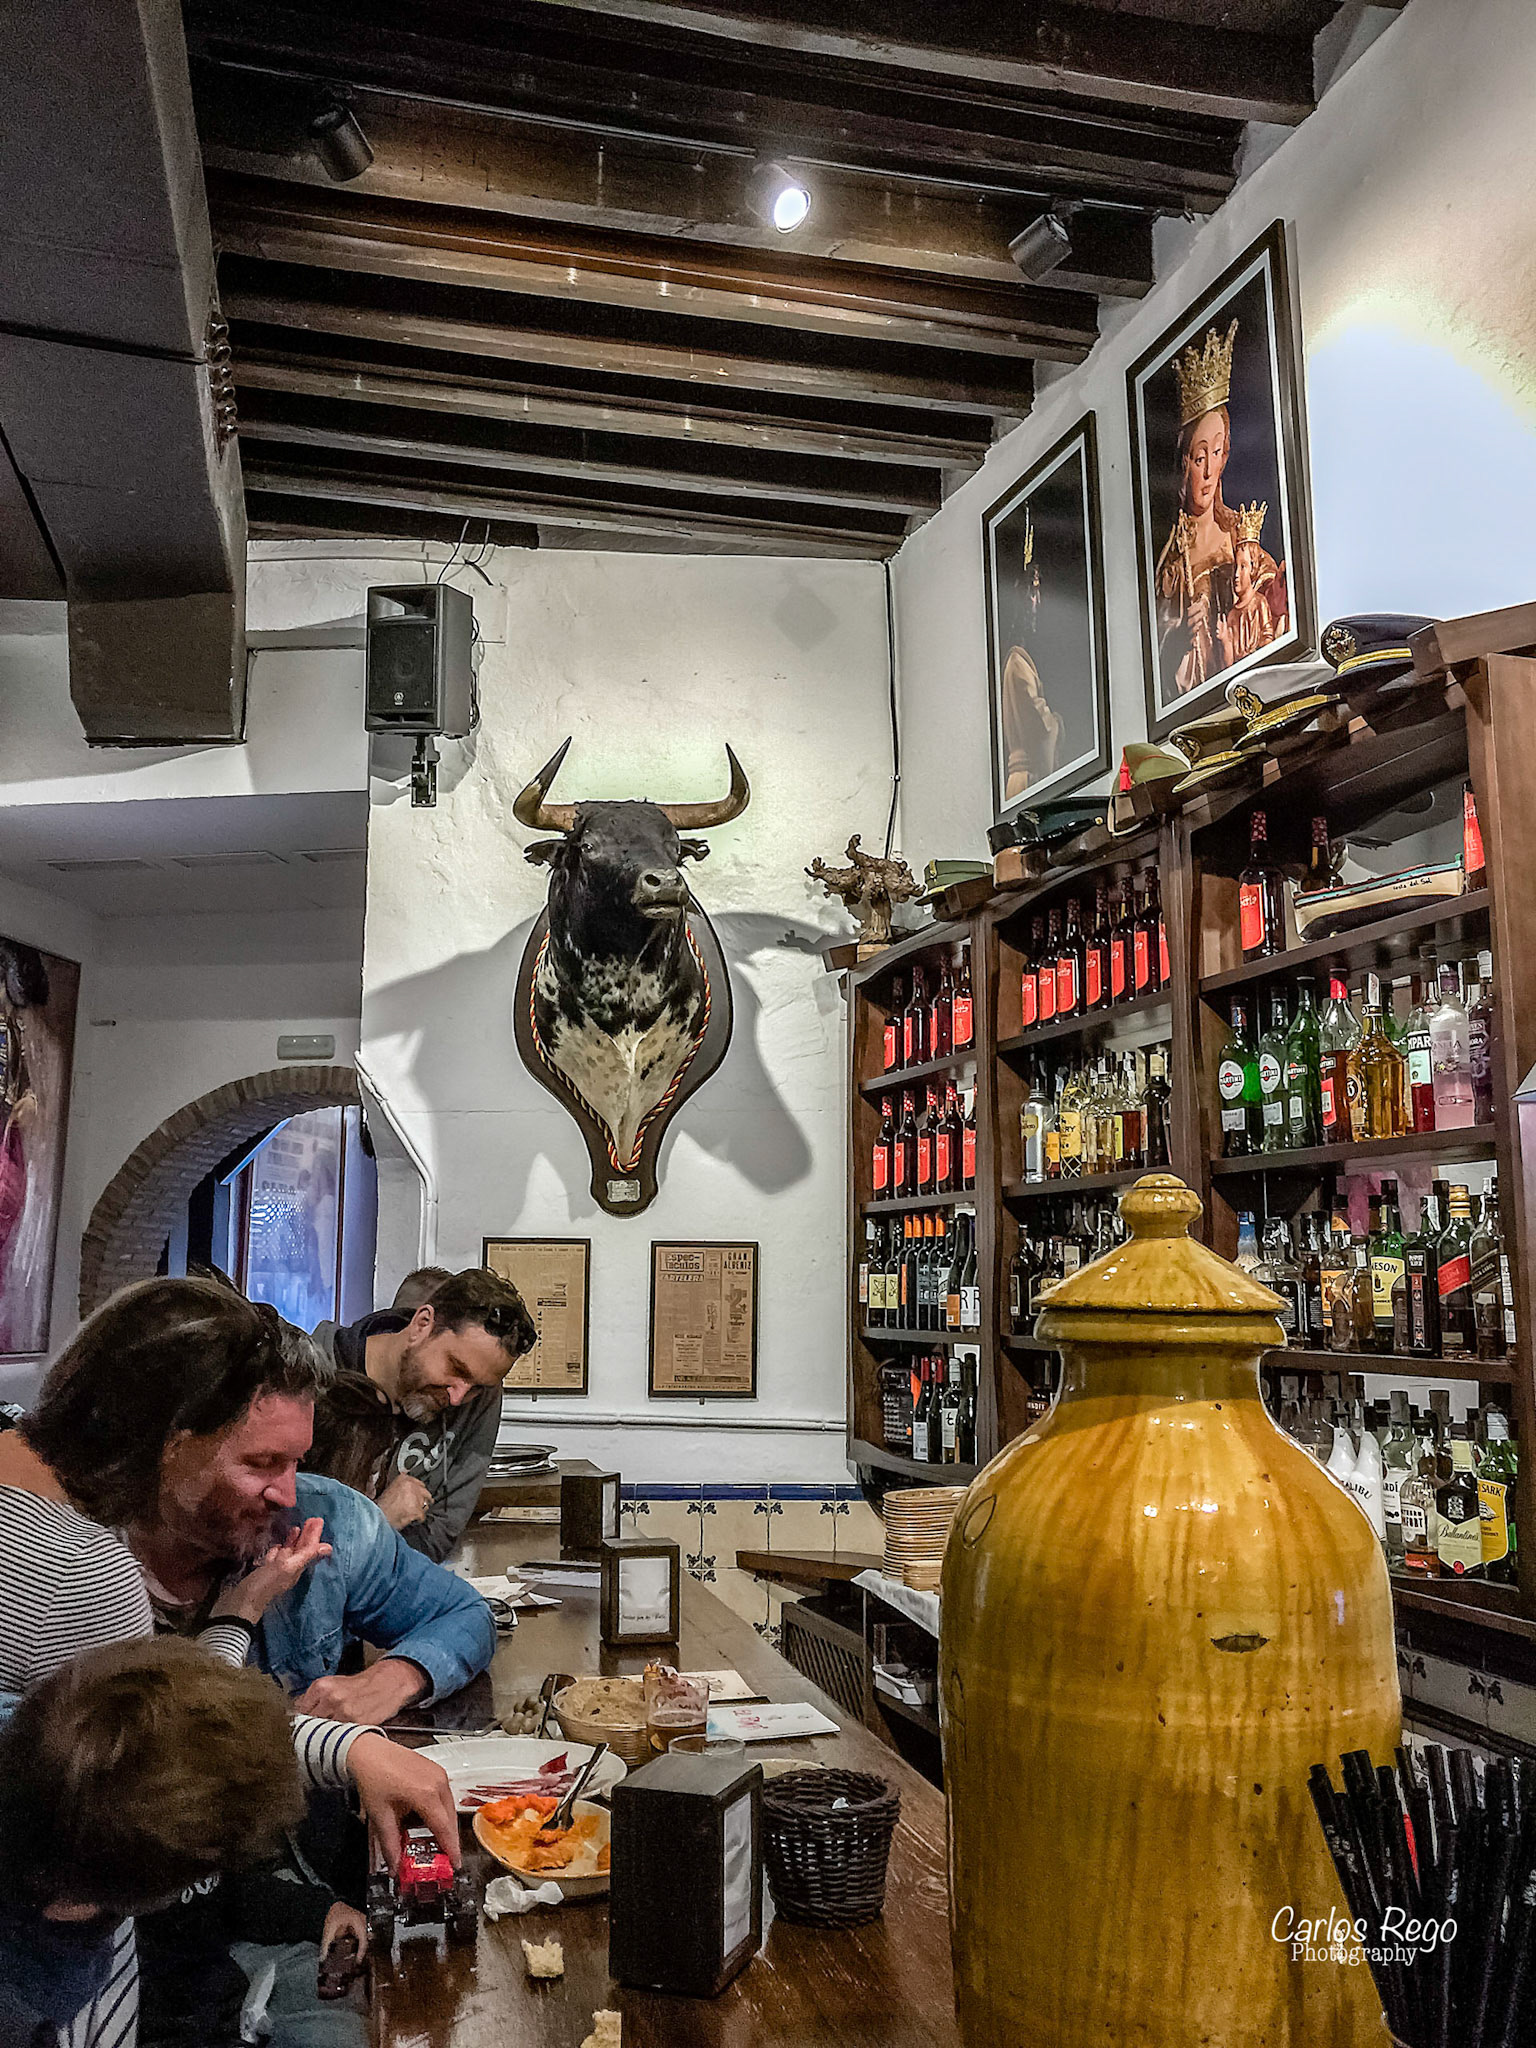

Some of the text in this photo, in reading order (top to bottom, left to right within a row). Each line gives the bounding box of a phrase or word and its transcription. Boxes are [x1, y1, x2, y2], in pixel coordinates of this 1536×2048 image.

[1408, 1035, 1431, 1051] MPAR
[1372, 1262, 1398, 1274] ESON
[1343, 1480, 1373, 1500] ALIBU
[1481, 1484, 1502, 1497] SARK
[1439, 1524, 1479, 1541] Ballantine's
